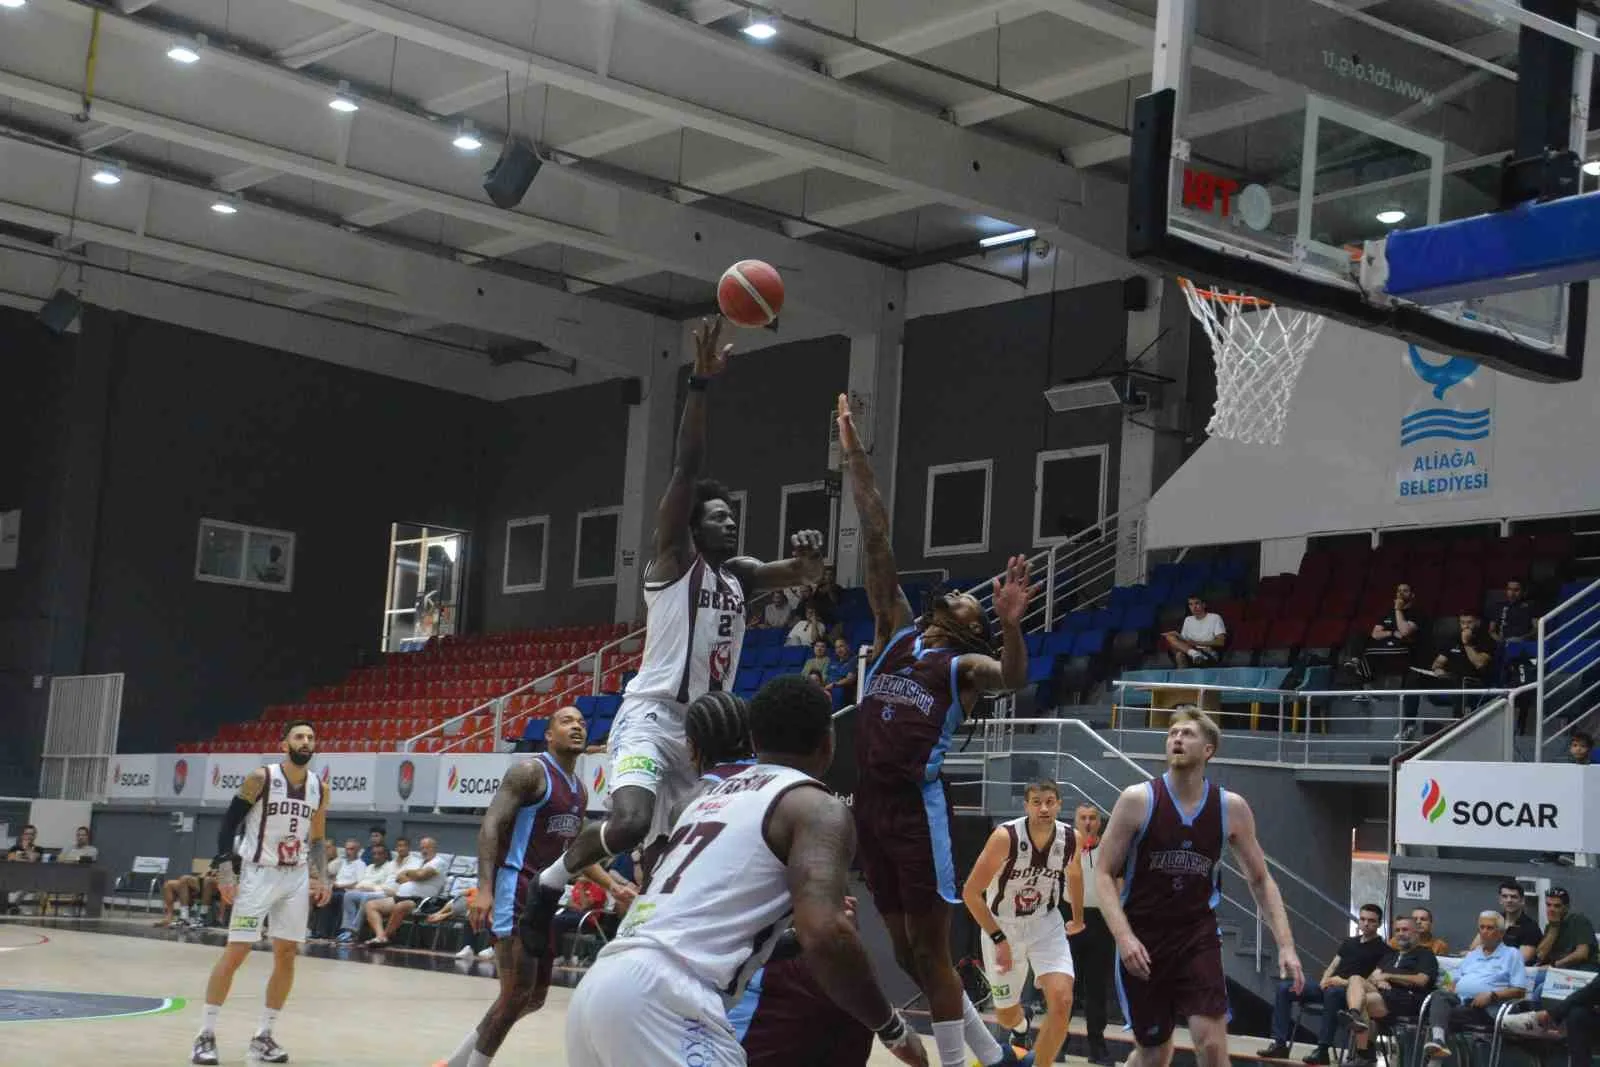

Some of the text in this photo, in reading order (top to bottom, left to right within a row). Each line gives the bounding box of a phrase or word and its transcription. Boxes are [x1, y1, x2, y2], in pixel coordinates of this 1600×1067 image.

[1413, 449, 1477, 472] ALİAĞA
[1400, 468, 1489, 497] BELEDİYESİ
[222, 775, 245, 789] SOC
[332, 776, 367, 791] SOCAR
[459, 778, 500, 795] SOCAR
[1452, 800, 1558, 829] SOCAR
[1402, 880, 1425, 893] VIP
